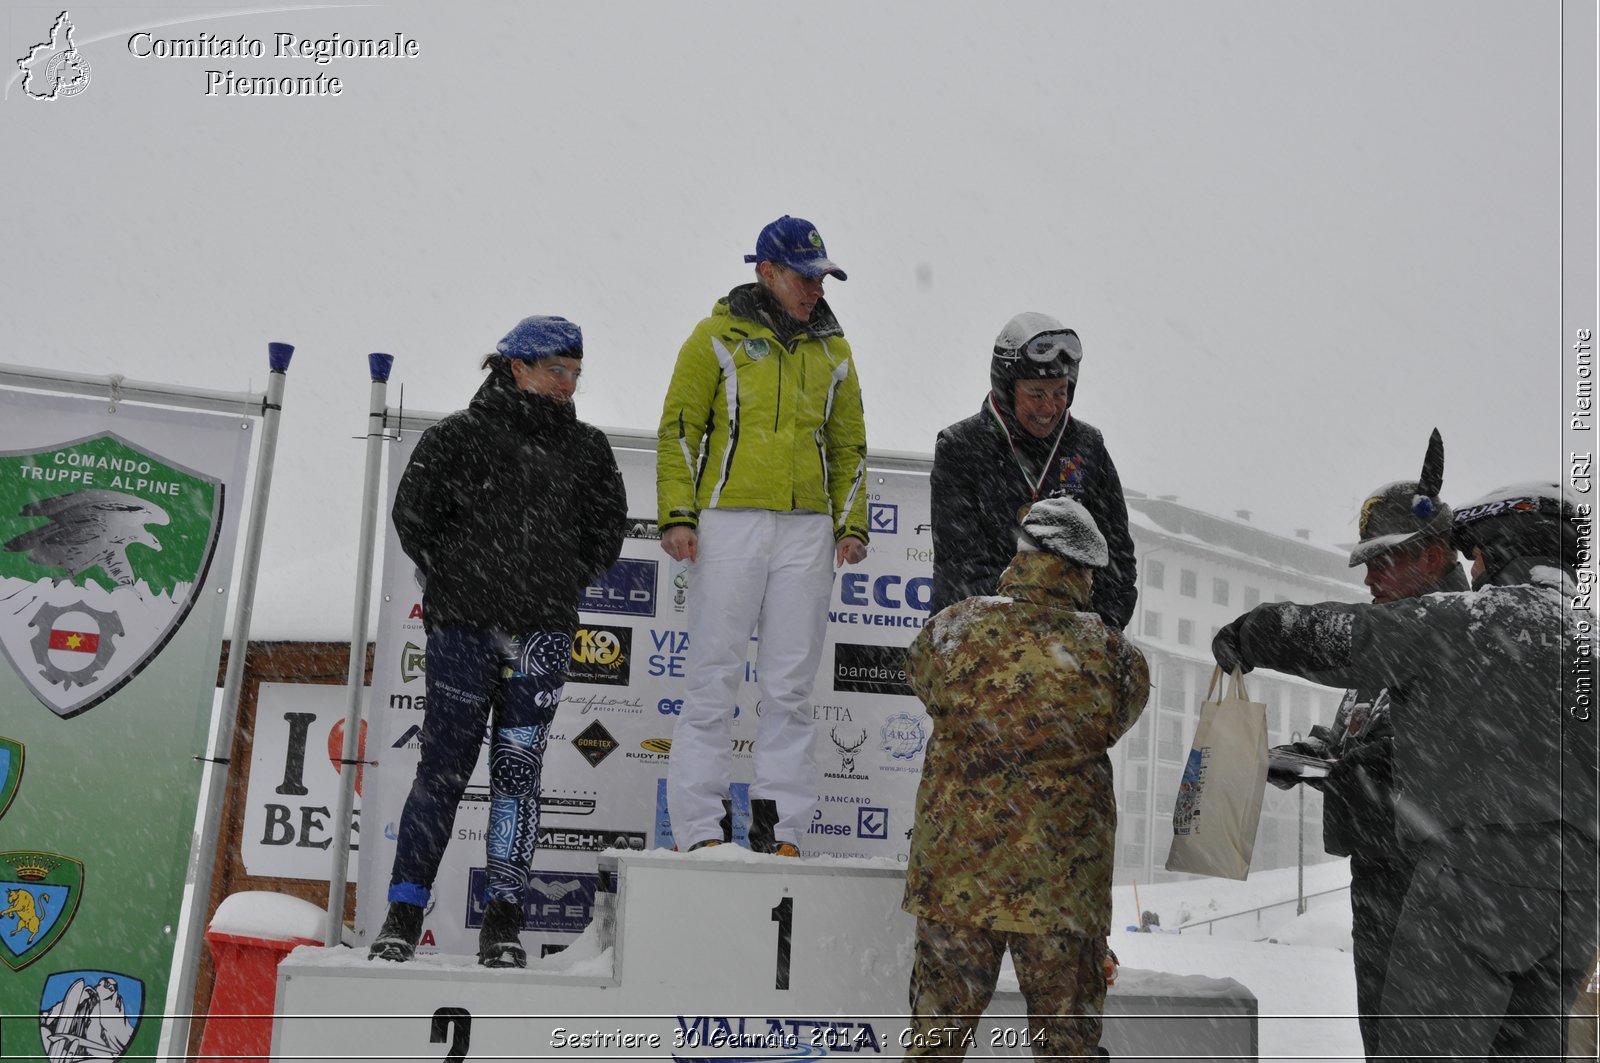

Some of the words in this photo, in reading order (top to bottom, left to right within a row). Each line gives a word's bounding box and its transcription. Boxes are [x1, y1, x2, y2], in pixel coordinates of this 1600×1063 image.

[54, 452, 151, 475] COMANDO
[20, 465, 94, 485] TRUPPE
[110, 475, 181, 496] ALPINE
[1455, 499, 1523, 521] RUDY
[833, 572, 933, 611] ECO
[609, 653, 625, 670] ITALY
[839, 664, 906, 681] bandave
[813, 705, 852, 721] ETTA
[578, 738, 612, 748] GORE-TEX
[888, 729, 917, 740] ARIS
[275, 712, 317, 796] I
[824, 772, 869, 781] PASSALACQUA
[825, 795, 871, 804] BANCARIO
[807, 820, 851, 836] inese
[771, 896, 793, 990] 1
[430, 1007, 471, 1063] 2
